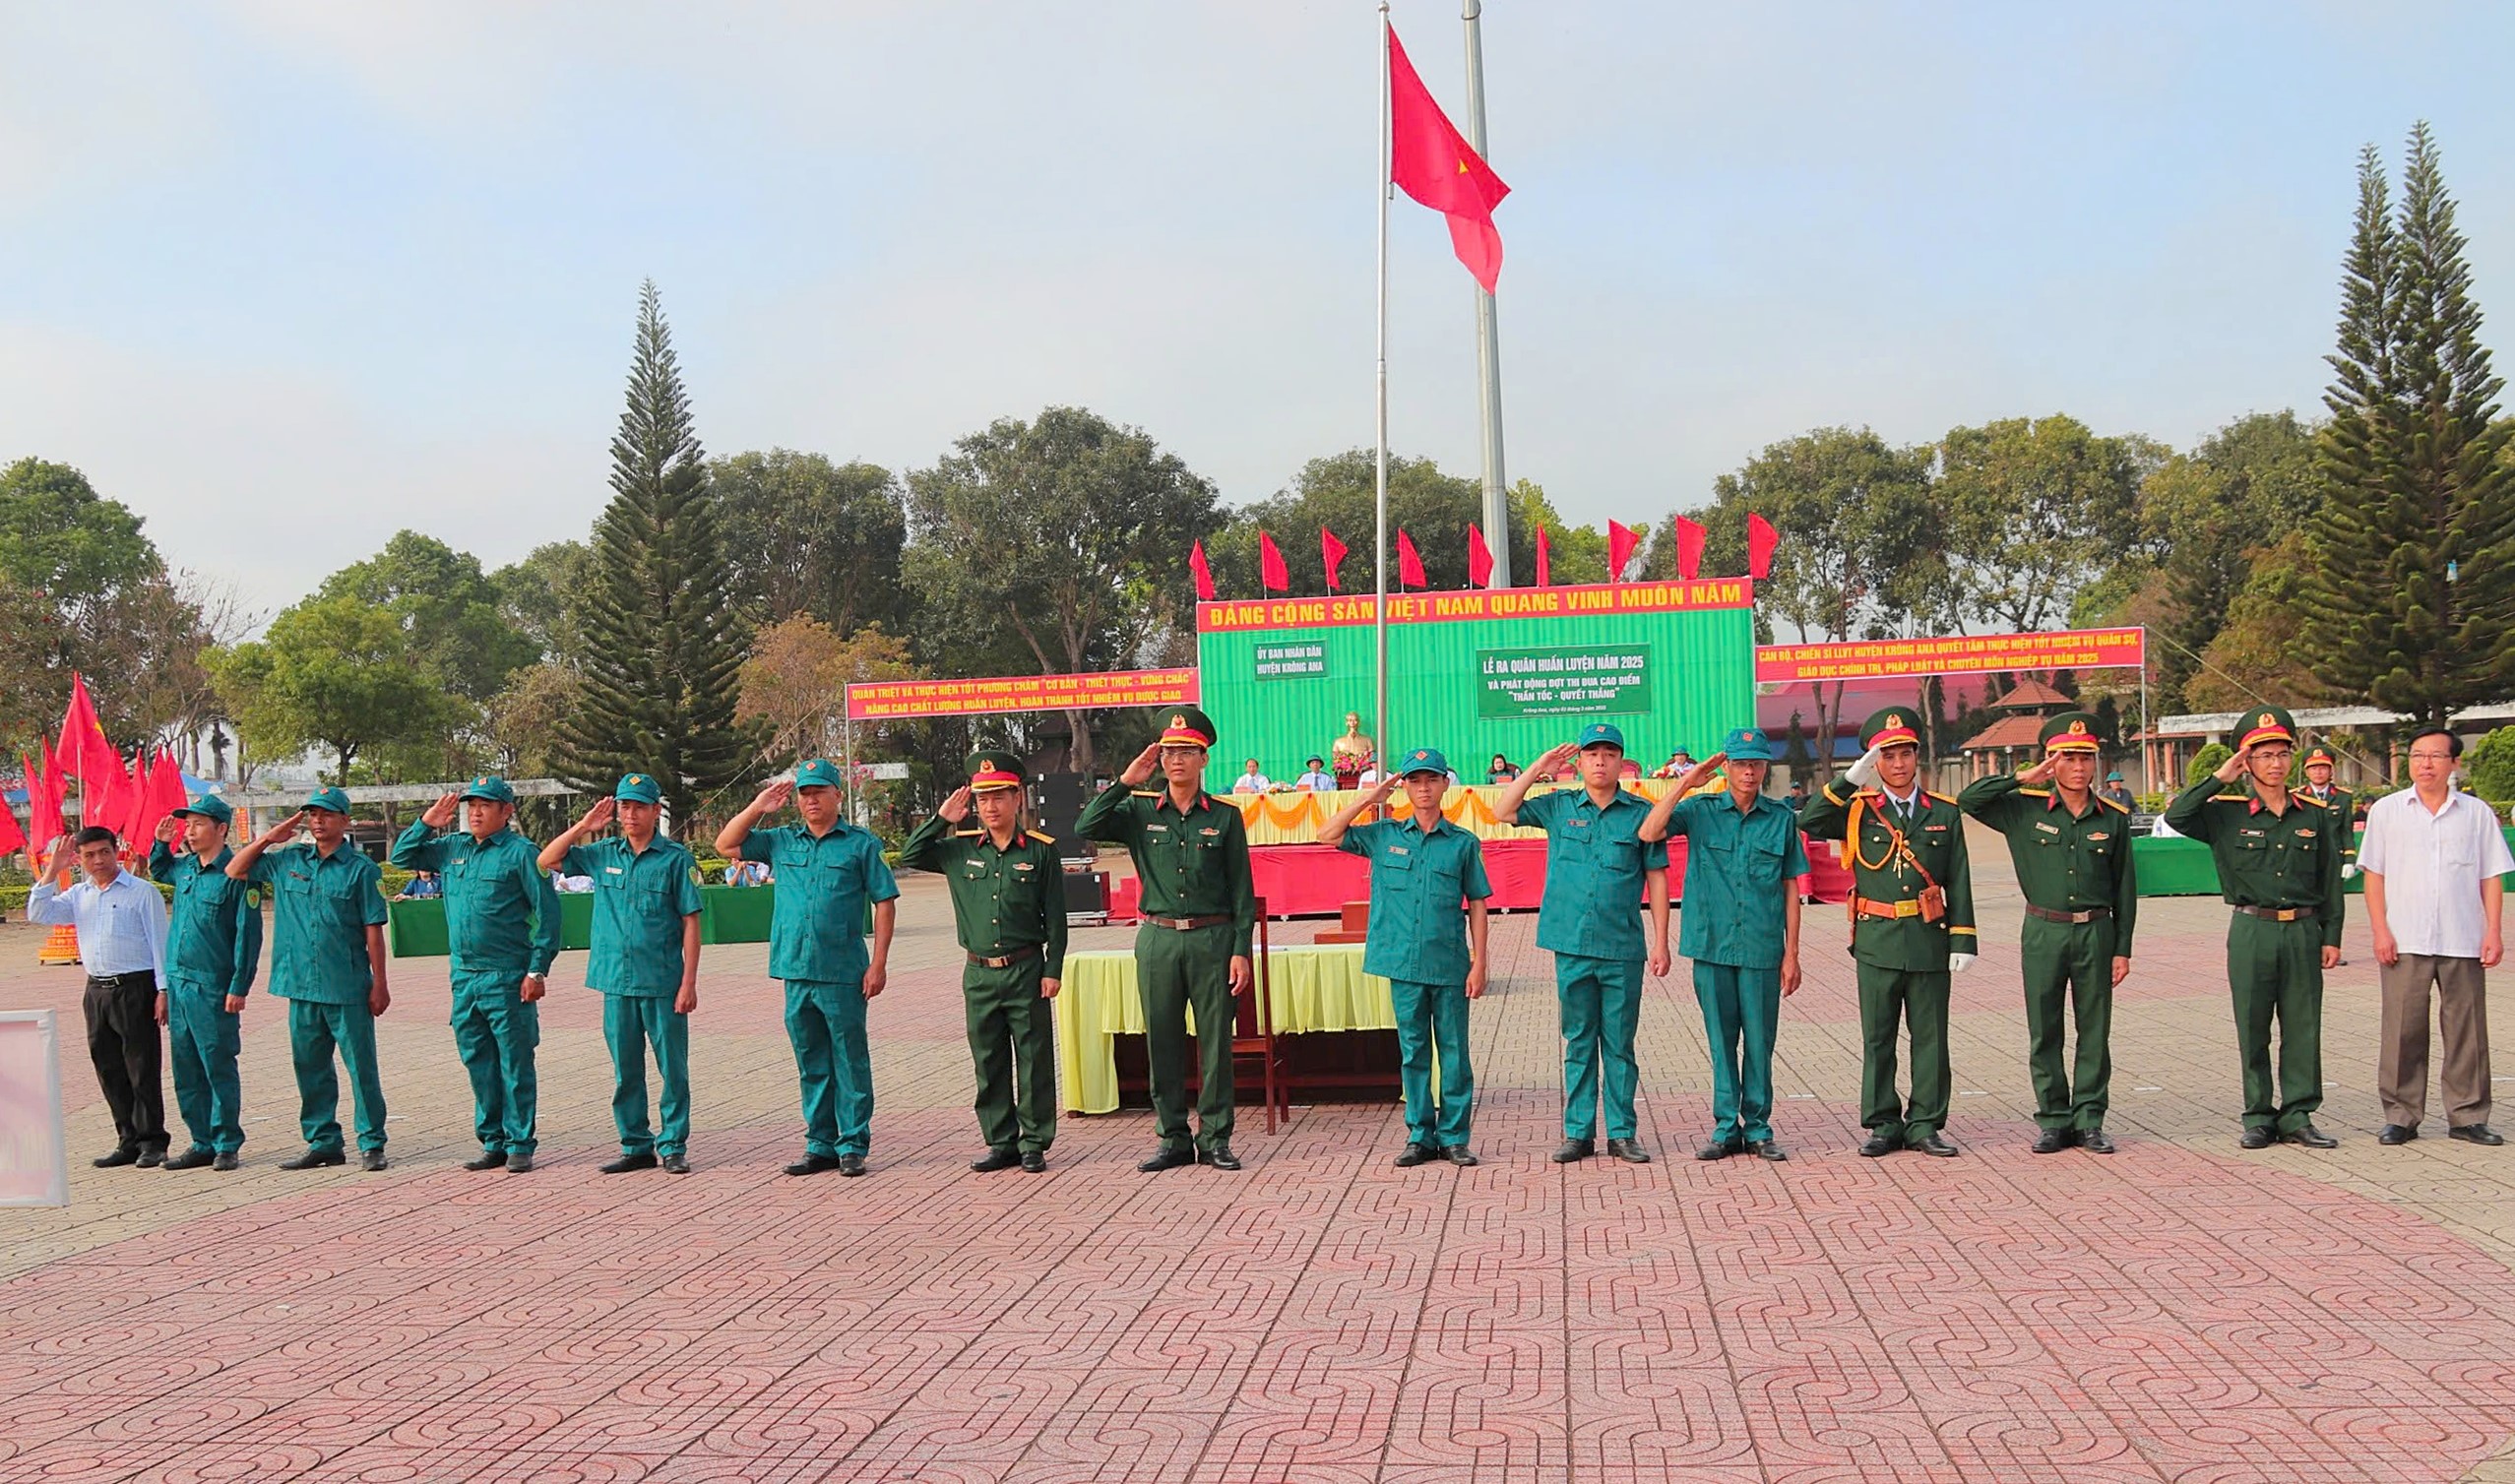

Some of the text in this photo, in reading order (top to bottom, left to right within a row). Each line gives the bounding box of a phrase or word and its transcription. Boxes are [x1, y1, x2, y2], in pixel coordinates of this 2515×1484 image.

[1210, 603, 1265, 626] ĐẢNG
[1272, 601, 1326, 625] CỘNG
[1332, 598, 1374, 621] SẢN
[1436, 598, 1483, 616] NAM
[1490, 593, 1559, 614] QUANG
[1566, 591, 1613, 609] VINH
[1620, 586, 1684, 607] MUÔN
[1691, 583, 1741, 603] NĂM
[1257, 645, 1322, 659] ỦY BAN NHÂN DÂN
[1257, 660, 1323, 676] HUYỆN KRÔNG ANA
[1482, 653, 1644, 674] LỄ RA QUÂN HUẤN LUYỆN NĂM 2025
[1487, 673, 1641, 690] VÀ PHÁT ĐỘNG ĐỢT THI ĐUA CAO ĐIỂM
[1537, 689, 1552, 701] TỐC
[1560, 688, 1586, 701] QUYẾT
